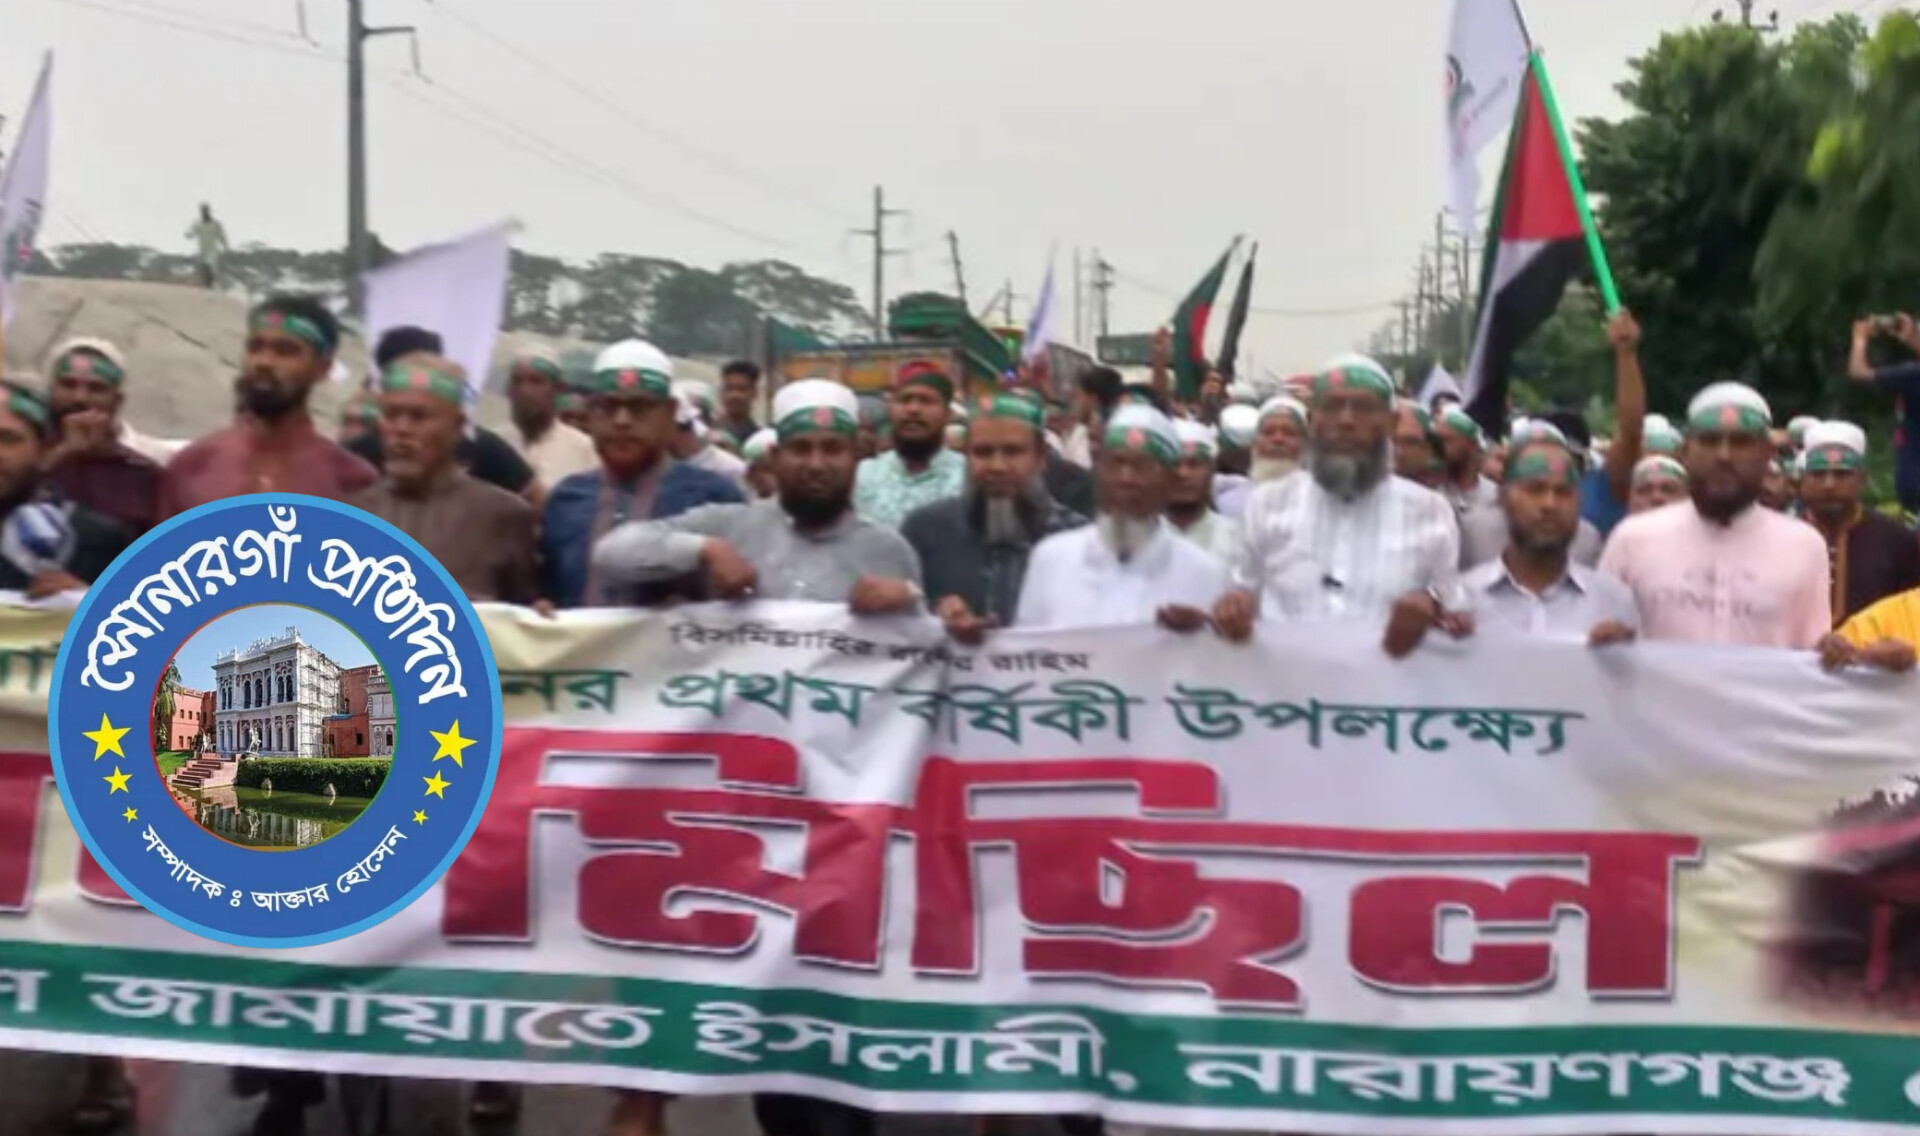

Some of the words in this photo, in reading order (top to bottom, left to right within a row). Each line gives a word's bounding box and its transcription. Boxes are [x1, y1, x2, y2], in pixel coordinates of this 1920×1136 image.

[658, 668, 878, 728] প্রথম
[1165, 683, 1586, 754] উপলক্ষ্যে
[81, 972, 662, 1050] জামায়াতে
[1177, 1043, 1852, 1108] নারায়ণগঞ্জ
